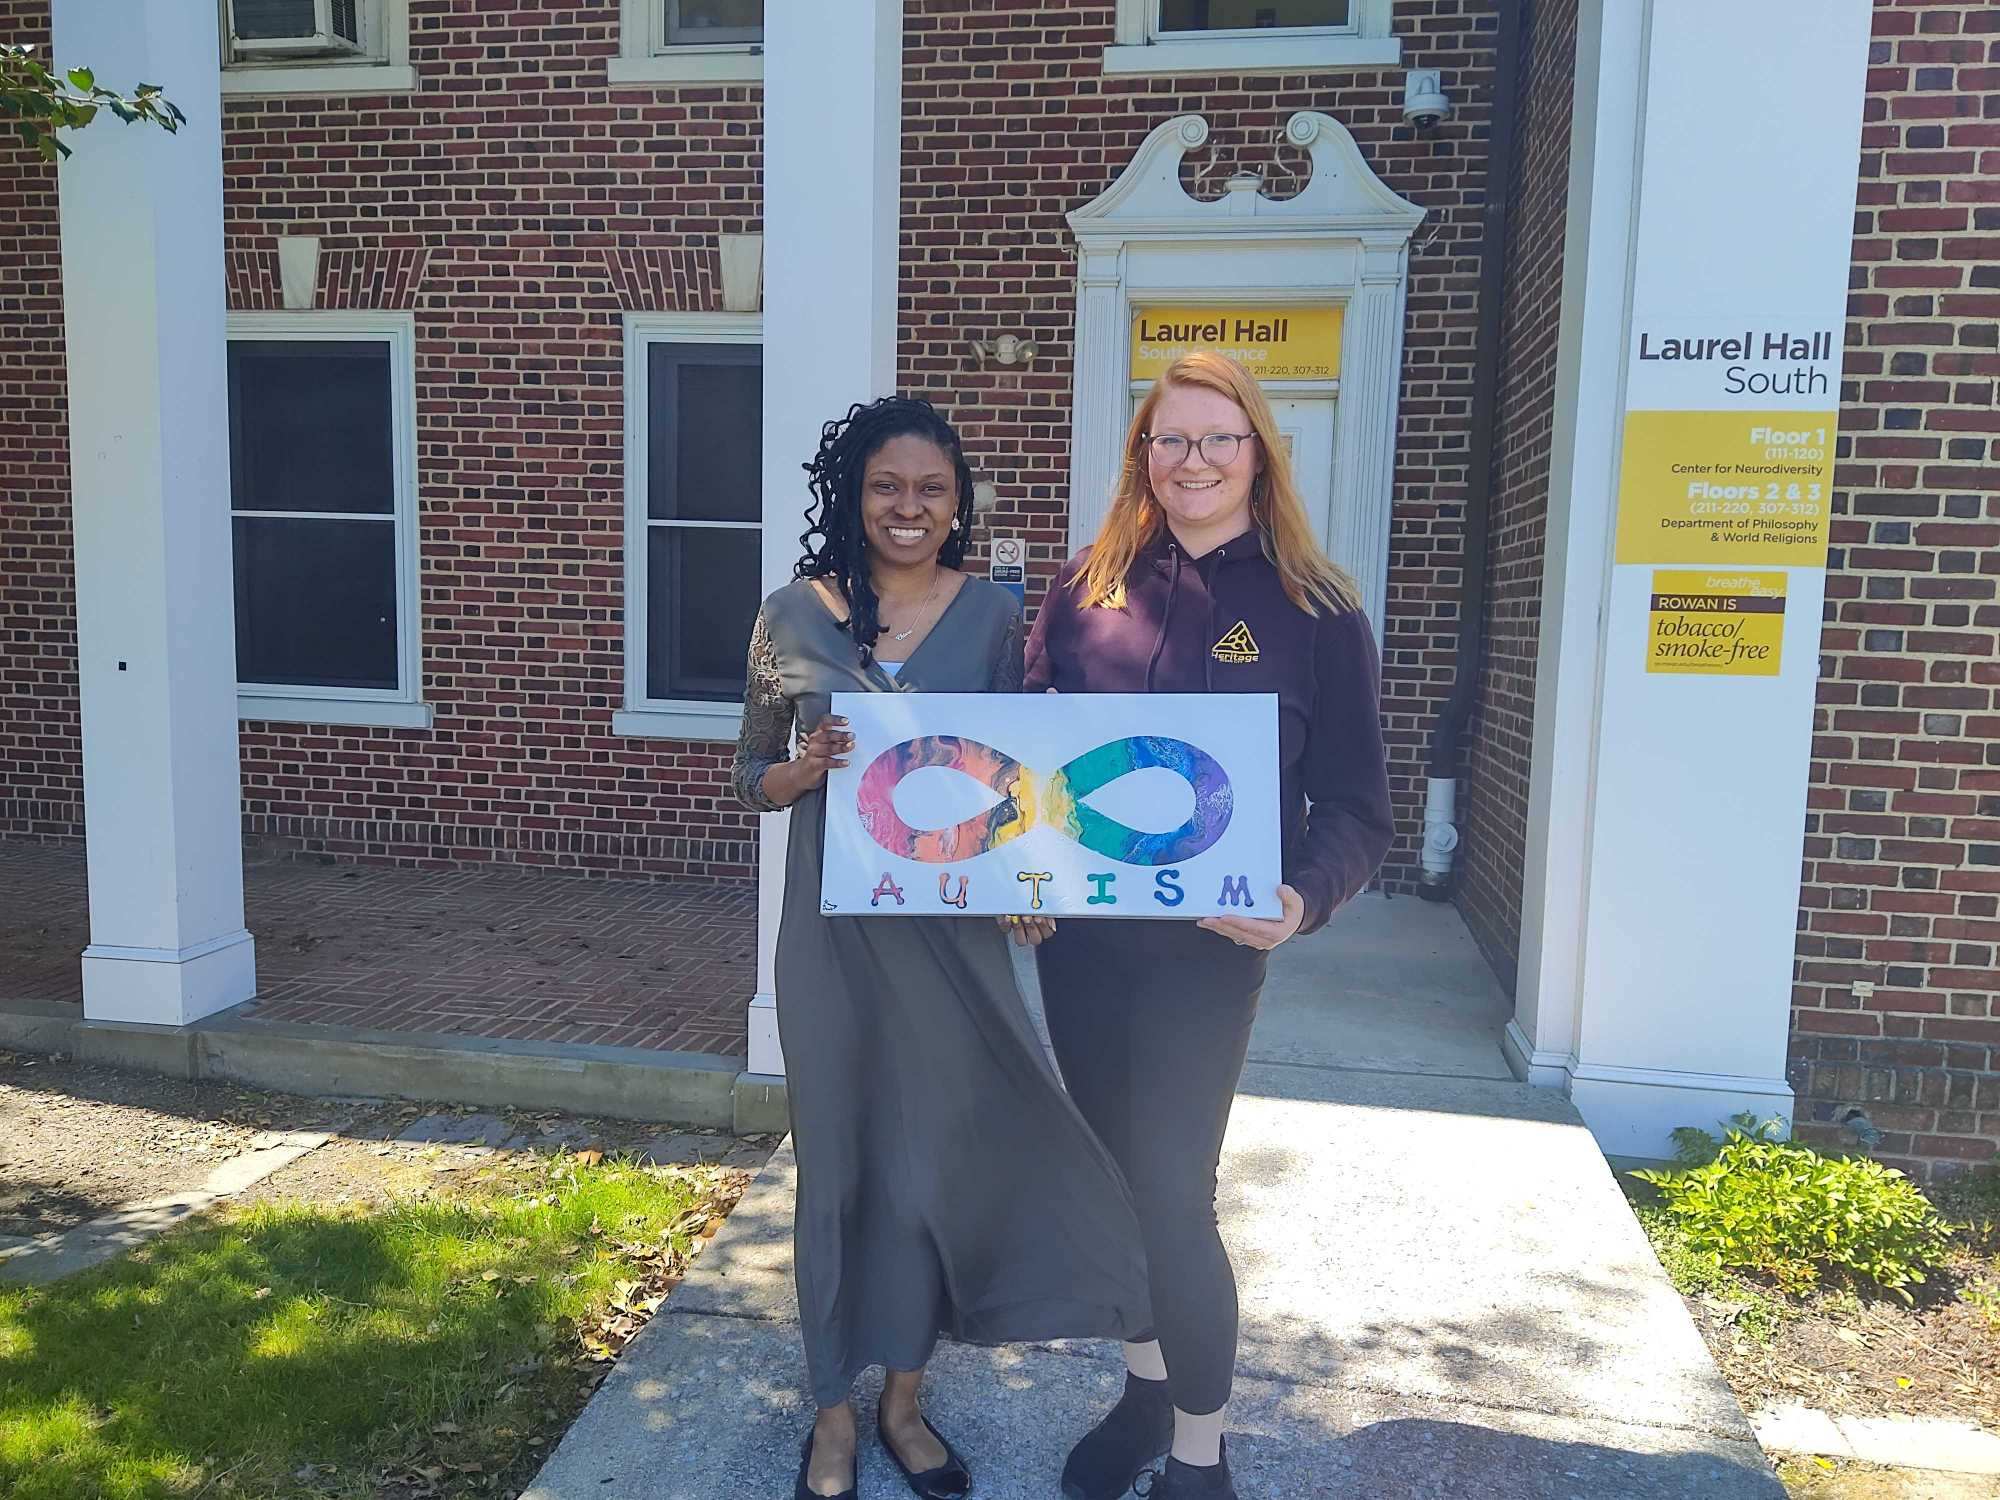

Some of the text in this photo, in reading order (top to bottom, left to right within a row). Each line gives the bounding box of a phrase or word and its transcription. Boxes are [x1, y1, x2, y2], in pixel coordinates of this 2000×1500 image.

[1140, 318, 1289, 342] Laurel Hall
[1639, 331, 1832, 360] Laurel Hall
[1293, 366, 1330, 376] 307-312
[1724, 365, 1827, 394] South
[1750, 427, 1826, 445] Floor 1
[1765, 447, 1824, 461] (111-120)
[1671, 463, 1823, 477] Center for Neurodiversity
[1687, 481, 1822, 500] Floors 2 & 3
[1690, 502, 1820, 516] (211-220, 307-312)
[1661, 518, 1818, 532] Department of Philosophy
[1711, 532, 1818, 545] & World Religions
[1706, 575, 1761, 588] breathe
[1658, 597, 1737, 610] ROWAN IS
[1656, 615, 1746, 639] tobacco/
[1211, 651, 1259, 663] Heritage
[1655, 638, 1770, 665] smoke-free
